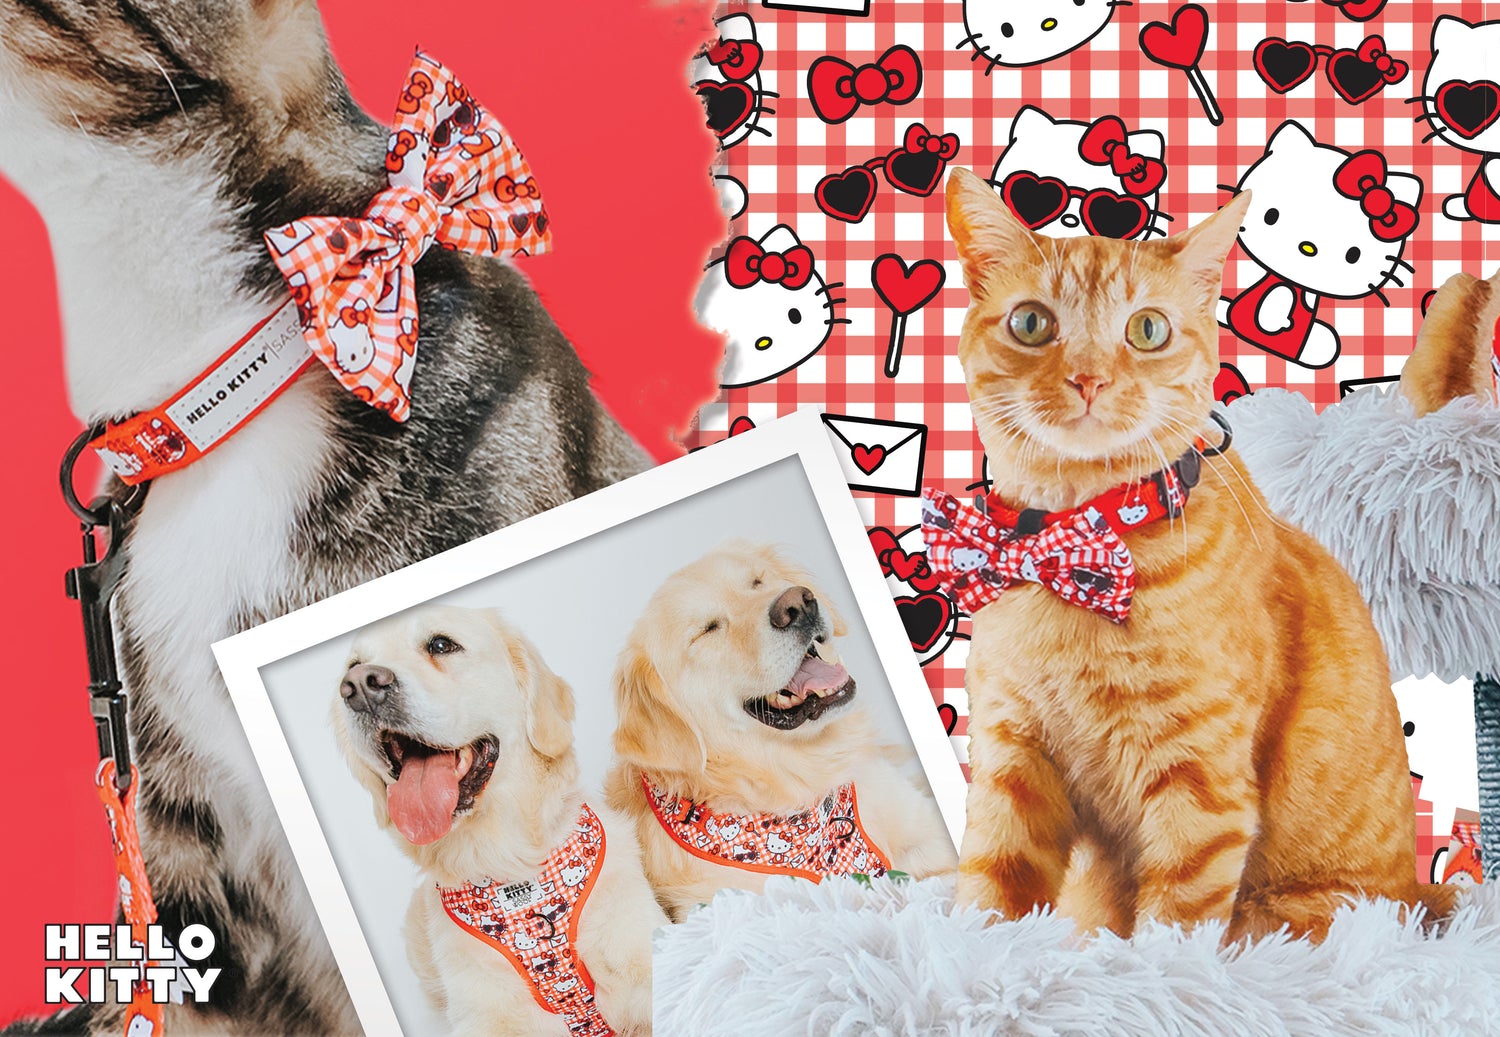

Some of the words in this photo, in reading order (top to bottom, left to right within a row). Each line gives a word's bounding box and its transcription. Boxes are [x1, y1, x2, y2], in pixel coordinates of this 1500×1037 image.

[186, 390, 228, 425] HELLO
[226, 351, 269, 392] KITTY
[271, 320, 302, 353] SASS
[505, 885, 533, 900] KITTY
